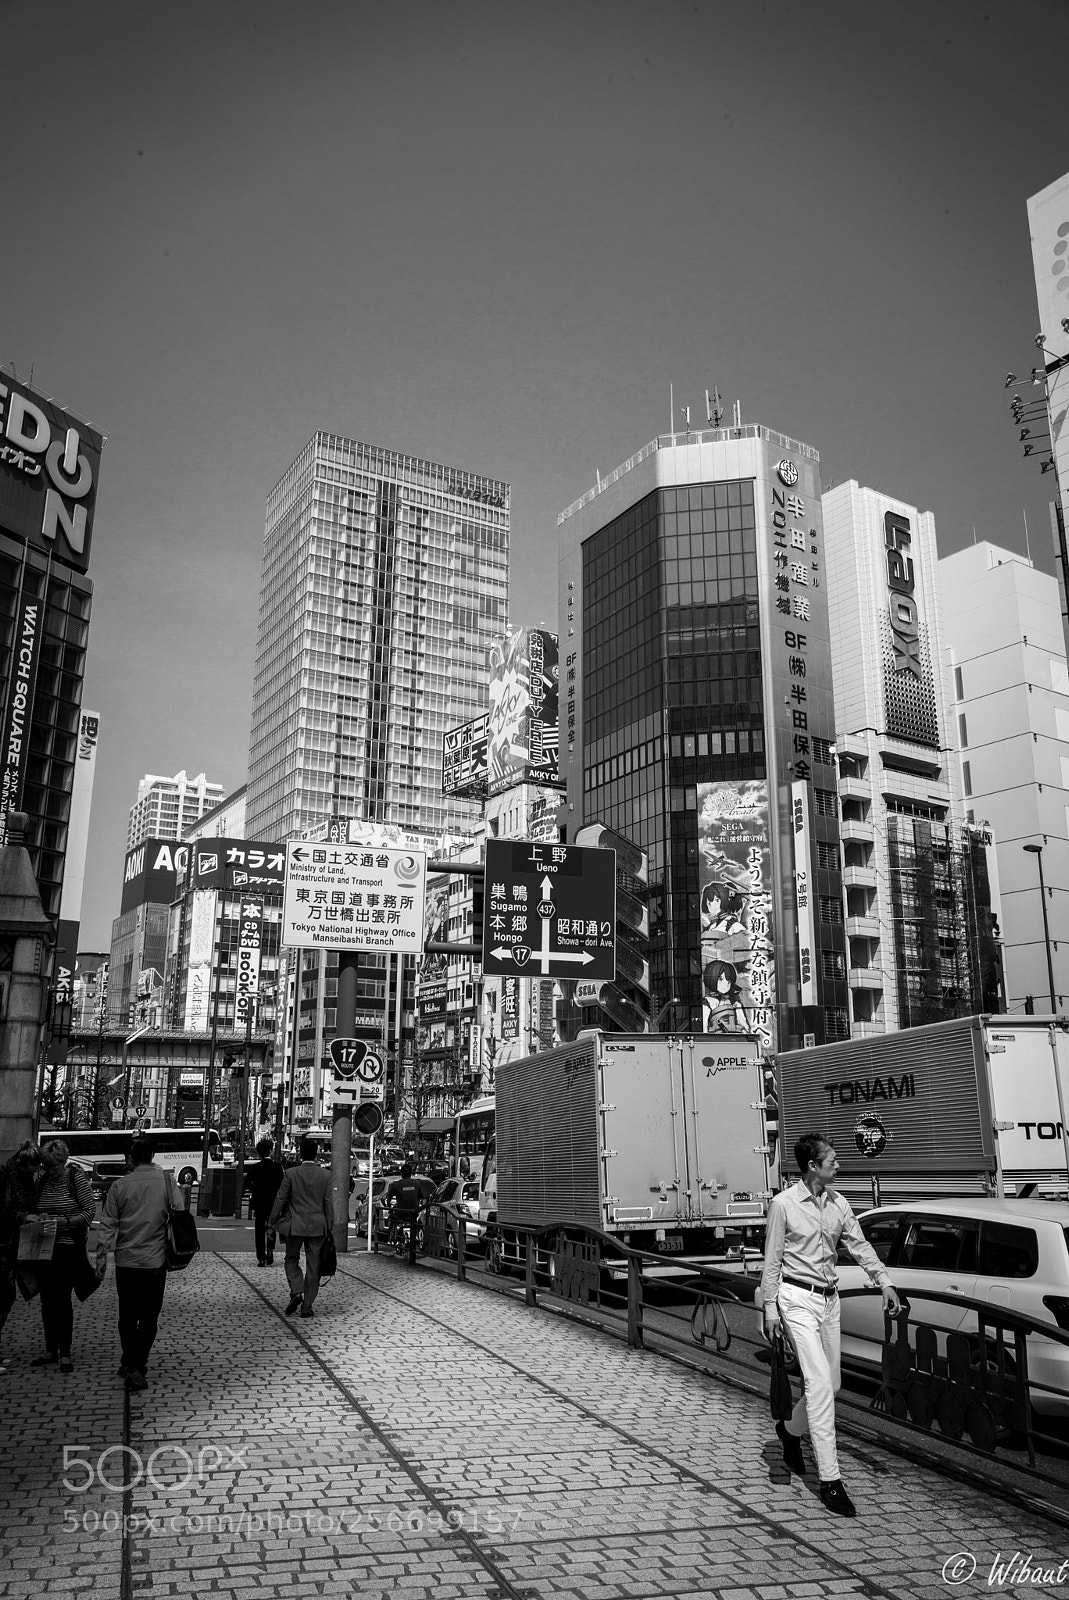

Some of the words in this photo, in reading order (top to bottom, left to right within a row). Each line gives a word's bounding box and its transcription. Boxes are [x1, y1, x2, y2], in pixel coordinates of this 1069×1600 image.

[787, 496, 811, 622] 半田産業
[17, 604, 38, 679] WATCH
[784, 630, 807, 650] 8F
[566, 651, 577, 667] 8F
[529, 674, 544, 718] DUTY
[6, 680, 28, 767] SQUARE
[528, 718, 544, 767] FREE
[529, 769, 550, 779] AKKY
[793, 798, 804, 834] SEGA
[721, 822, 744, 831] SEGA
[226, 847, 286, 872] カラオ
[312, 849, 390, 868] 国土交通省
[528, 845, 567, 863] 上野
[125, 847, 145, 883] AOKI
[290, 863, 316, 873] Ministry
[319, 865, 326, 873] of
[536, 862, 559, 873] Ueno
[248, 875, 286, 887] アドアー
[289, 872, 334, 883] Infrastructure
[337, 876, 350, 884] and
[352, 877, 383, 887] Transport
[490, 883, 528, 901] 巣鴨
[797, 871, 808, 909] 2号館
[295, 888, 414, 910] 東京国道事務所
[490, 901, 528, 912] Sugamo
[242, 903, 262, 919] 本
[307, 905, 401, 924] 万世橋出張所
[539, 905, 553, 914] 437
[244, 921, 258, 930] CD
[291, 922, 316, 933] Tokyo
[319, 924, 353, 934] National
[355, 927, 389, 936] Highway
[391, 928, 416, 938] Office
[489, 913, 528, 932] 本郷
[557, 918, 611, 937] 昭和通り
[240, 929, 261, 939] ゲーム
[312, 933, 363, 944] Manseibashi
[365, 936, 394, 946] Branch
[493, 932, 523, 943] Hongo
[240, 938, 260, 948] DVD
[599, 938, 614, 948] Ave.
[748, 848, 771, 1047] ようこそ新たな鎮守府へ。
[515, 949, 528, 961] 17
[801, 947, 811, 985] SEGA
[577, 983, 597, 998] SEGA
[502, 1019, 518, 1029] AKKY
[504, 1028, 516, 1037] ONE
[340, 1048, 357, 1063] 17
[716, 1057, 747, 1067] APPLE
[824, 1073, 916, 1105] TONAMI
